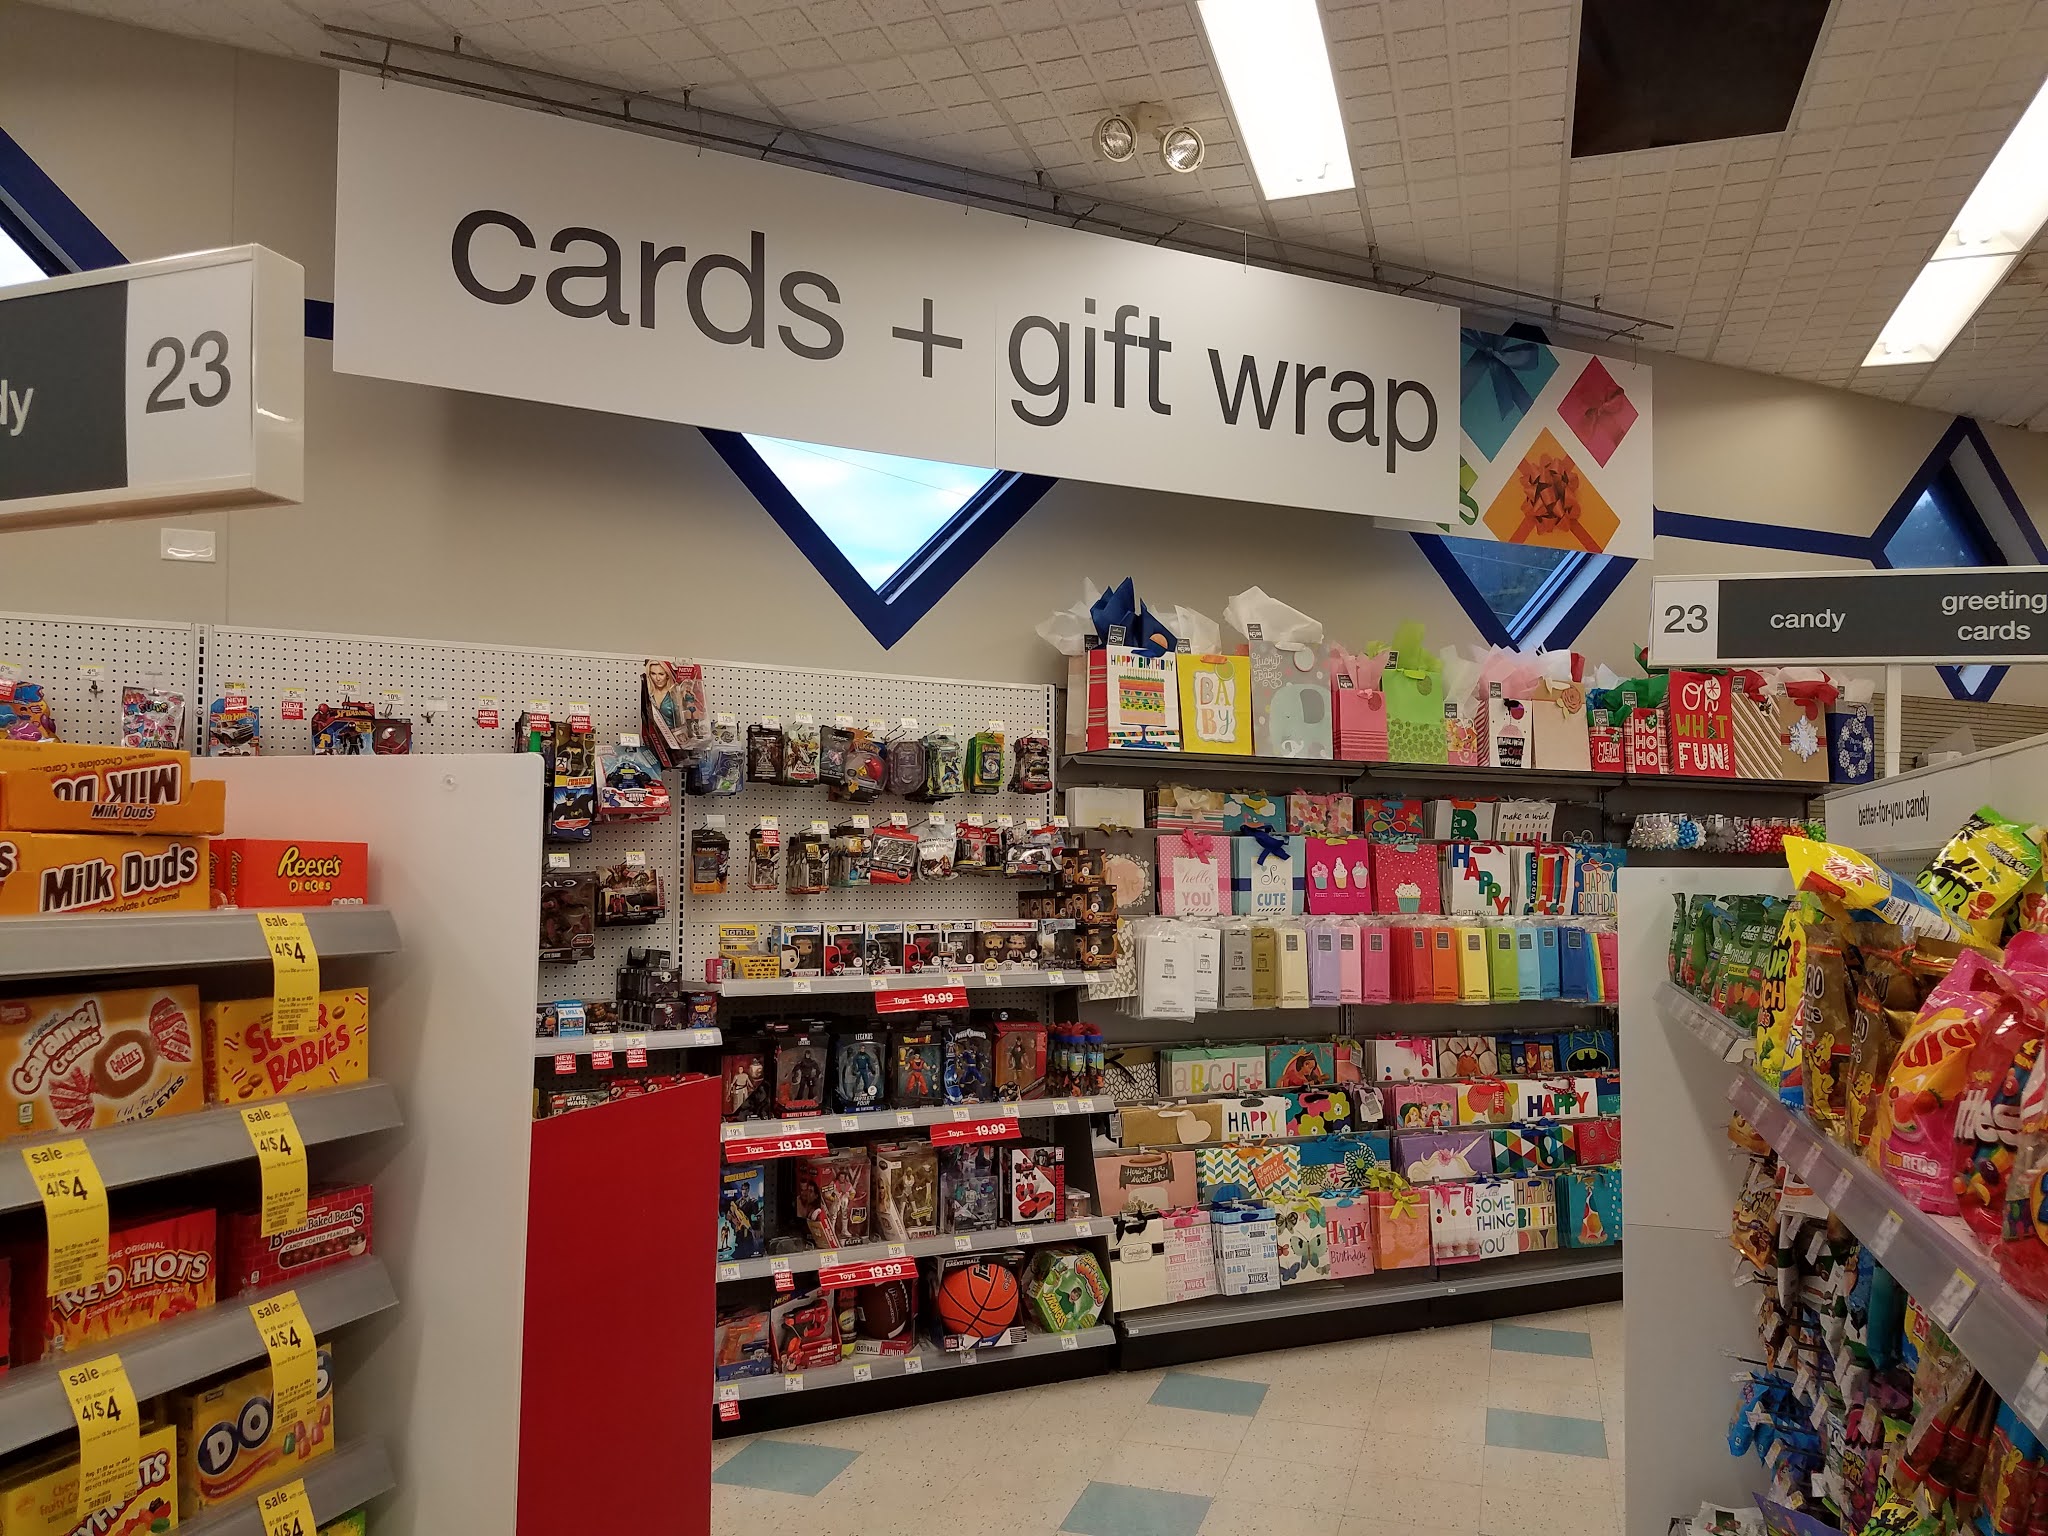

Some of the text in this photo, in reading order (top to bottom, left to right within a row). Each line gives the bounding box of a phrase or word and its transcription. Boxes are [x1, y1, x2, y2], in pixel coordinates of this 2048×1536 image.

[451, 208, 1439, 473] cards + gift wrap
[145, 330, 231, 414] 23
[1941, 589, 2048, 616] greeting
[1664, 604, 1709, 634] 23
[1770, 608, 1846, 632] candy
[1957, 620, 2031, 641] cards
[1111, 655, 1174, 671] HAPPY BIRTHDAY
[479, 710, 496, 718] NEW
[1598, 742, 1621, 757] MERRY
[1636, 735, 1658, 750] HO
[1636, 751, 1658, 766] HO
[1678, 742, 1730, 771] FUN!
[106, 766, 180, 805] Milk
[91, 804, 156, 820] Milk Duds
[1502, 812, 1522, 821] make
[1532, 812, 1550, 821] wish
[1858, 790, 1931, 826] better-for-you candy
[277, 846, 342, 878] Reese's
[42, 859, 115, 912] Milk
[122, 844, 198, 895] Duds
[542, 880, 578, 888] ALO
[1182, 866, 1212, 886] hello
[1452, 845, 1510, 915] HAPPY
[1584, 872, 1613, 892] HAPPY
[147, 890, 180, 906] Caramel
[1182, 892, 1212, 906] YOU
[1256, 892, 1286, 906] CUTE
[1916, 870, 1967, 912] OUR
[265, 916, 289, 928] sale
[722, 928, 756, 936] Tonka
[921, 992, 954, 1005] 19.99
[13, 1000, 102, 1095] Caramel
[266, 1024, 351, 1094] BABIES
[1527, 1091, 1589, 1118] HAPPY
[248, 1108, 272, 1123] sale
[1228, 1111, 1278, 1132] HAPPY
[947, 1123, 1006, 1138] Toys 19.99
[746, 1138, 813, 1154] Toys 19.99
[31, 1148, 63, 1164] sale
[1260, 1166, 1287, 1188] CUTENESS
[1056, 1164, 1064, 1224] TRANSFORMERS
[308, 1214, 334, 1230] Baked
[1518, 1206, 1555, 1228] BIRTH
[285, 1228, 350, 1251] CANDY COATED PEANUTS
[108, 1241, 166, 1262] THE ORIGINAL
[1330, 1250, 1367, 1264] Birthday
[946, 1258, 981, 1268] BASKETBALL
[1227, 1265, 1247, 1274] BABY
[838, 1264, 902, 1281] Toys 19.99
[1250, 1274, 1267, 1282] HUGS
[57, 1269, 124, 1313] RED
[130, 1252, 210, 1286] HOTS
[256, 1301, 281, 1320] sale
[817, 1344, 838, 1353] MEGA
[856, 1345, 880, 1354] OOTBALL
[882, 1348, 905, 1357] JUNIOR
[69, 1368, 100, 1386] sale
[264, 1490, 288, 1511] sale
